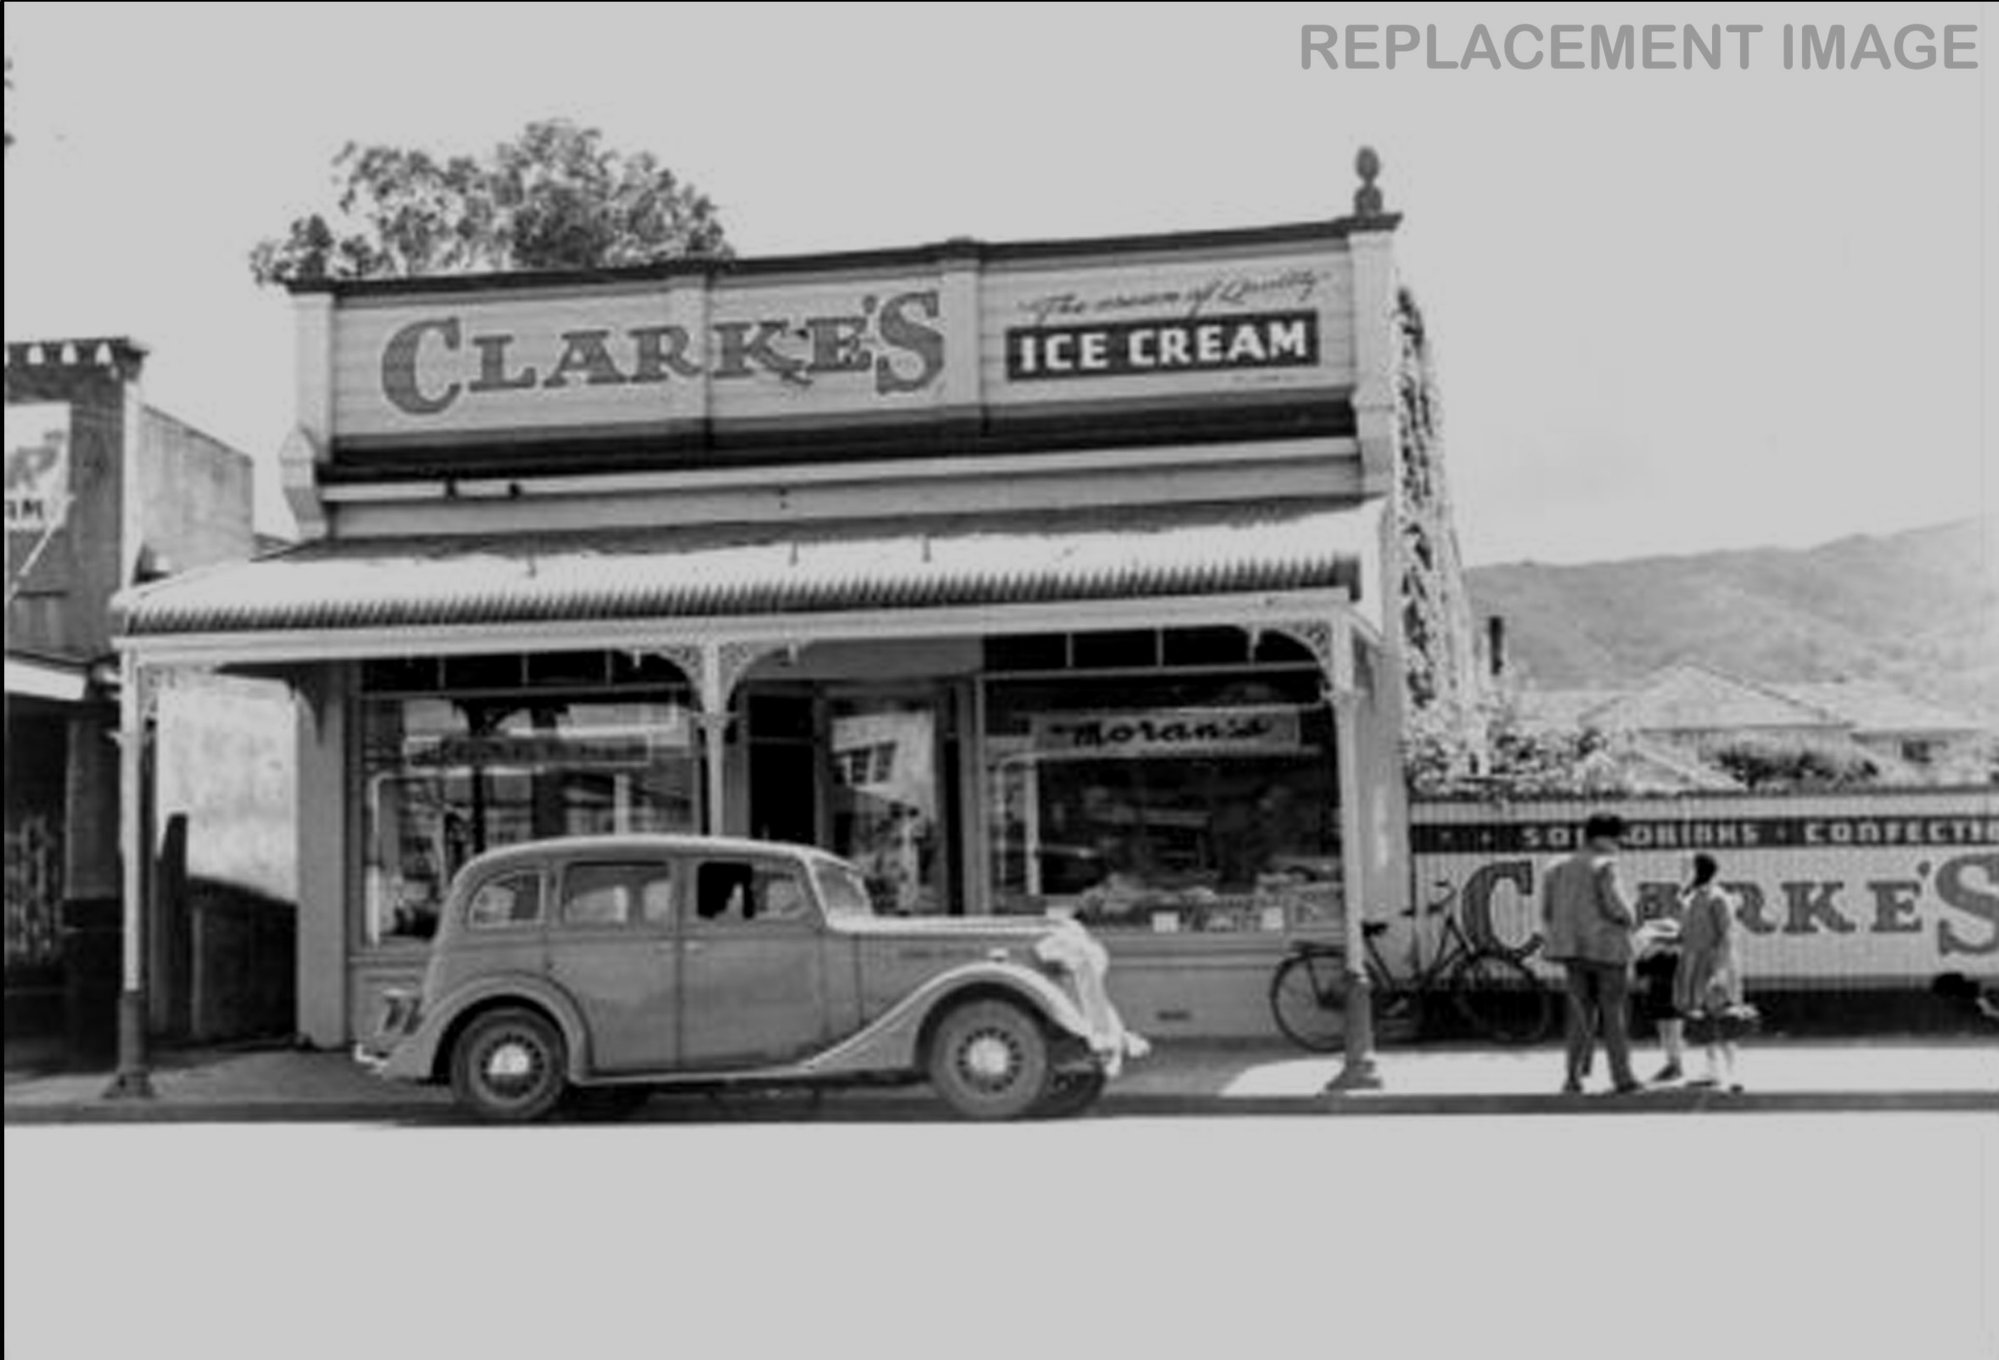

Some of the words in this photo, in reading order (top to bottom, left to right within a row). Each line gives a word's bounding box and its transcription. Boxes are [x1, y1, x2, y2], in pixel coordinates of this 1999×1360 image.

[381, 291, 944, 415] CLARKE'S
[1020, 332, 1107, 372] ICE
[1128, 321, 1306, 366] CREAM
